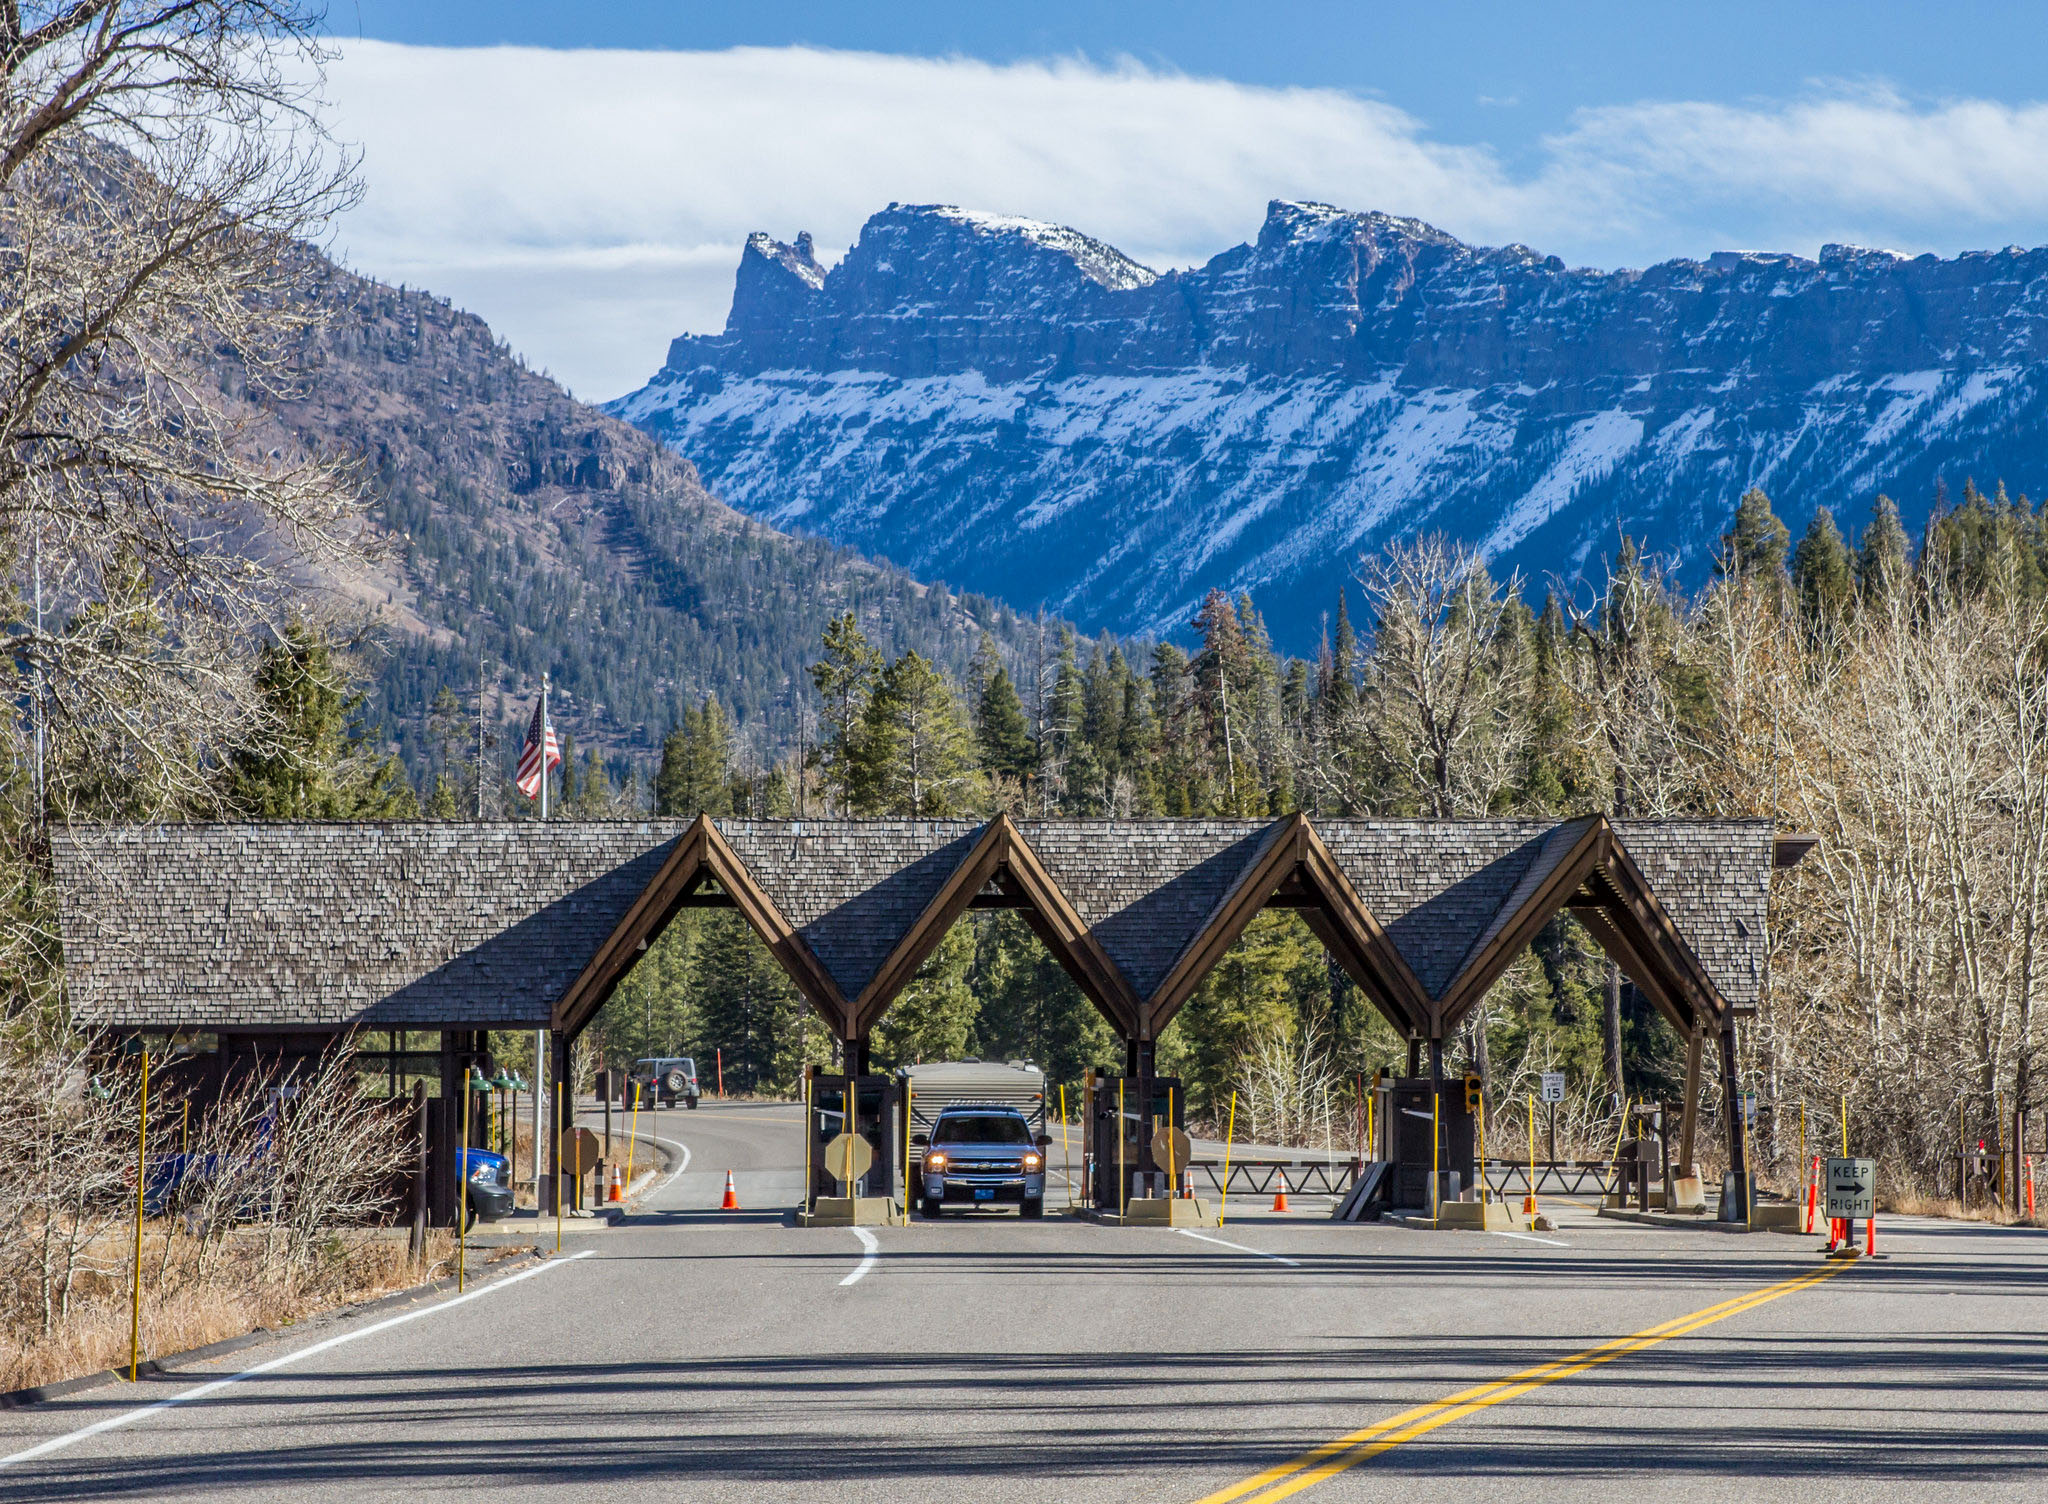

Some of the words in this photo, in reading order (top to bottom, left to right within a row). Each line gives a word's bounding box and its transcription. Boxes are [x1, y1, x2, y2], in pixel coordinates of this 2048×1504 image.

[1547, 1088, 1561, 1099] 15
[1833, 1167, 1869, 1178] KEEP
[1830, 1199, 1870, 1210] RIGHT
